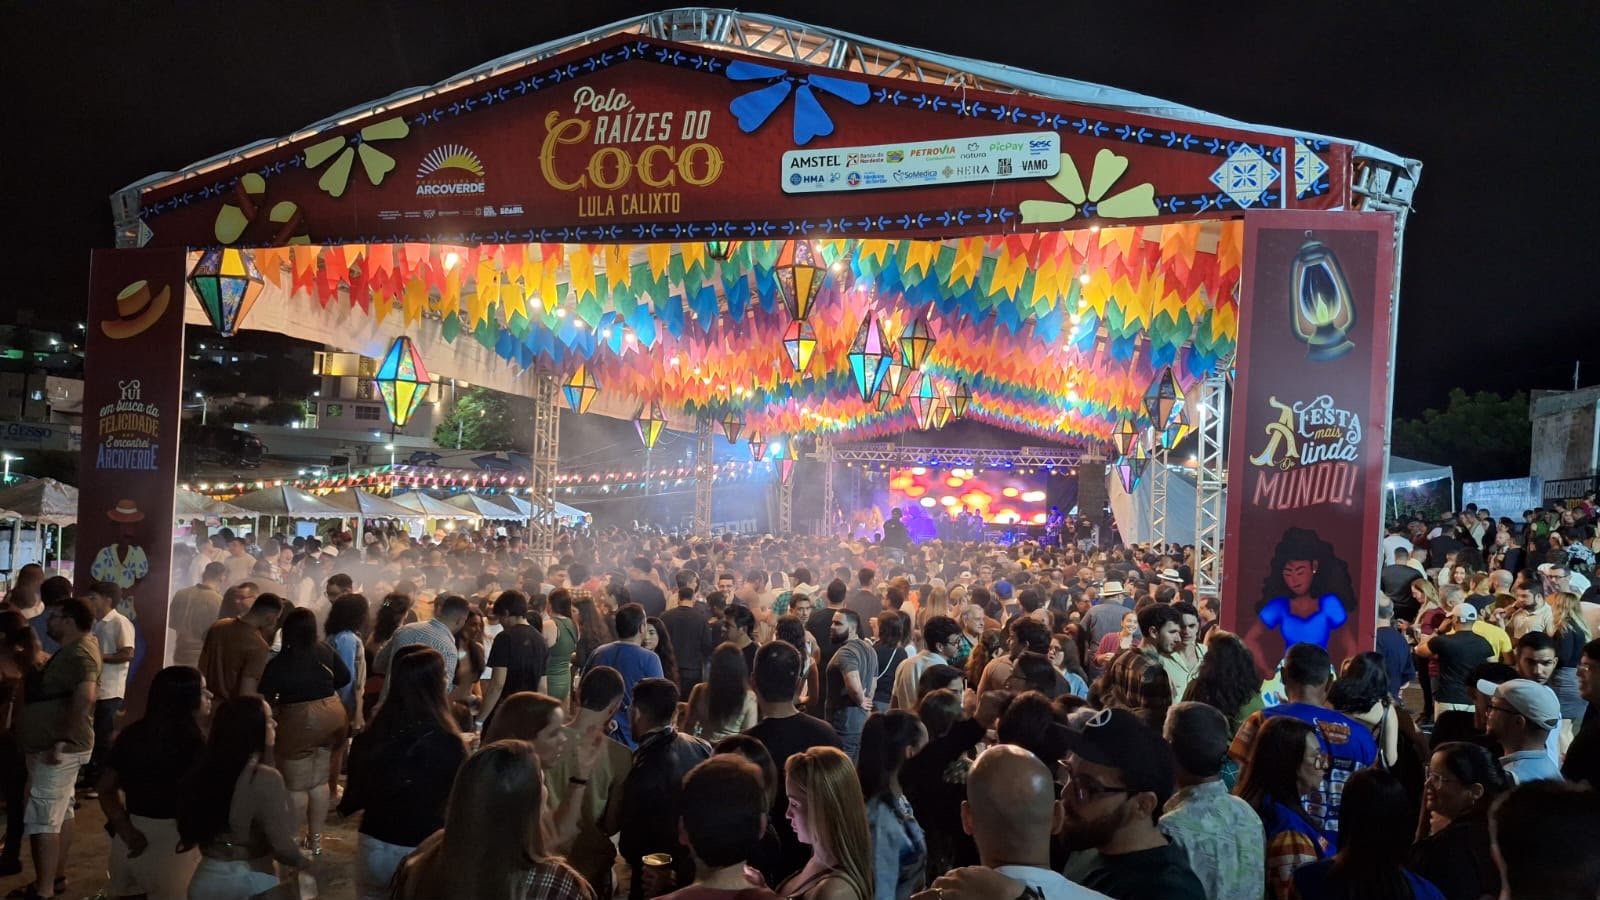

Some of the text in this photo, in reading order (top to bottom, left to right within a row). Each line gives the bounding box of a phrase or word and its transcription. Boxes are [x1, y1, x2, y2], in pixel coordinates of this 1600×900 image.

[574, 86, 631, 114] Polo
[594, 105, 711, 144] RAÍZES DO
[910, 145, 956, 157] PETROVIA
[989, 142, 1024, 152] PicPay
[791, 155, 840, 168] AMSTEL
[957, 165, 990, 175] HERA
[1022, 159, 1048, 171] VAMO
[416, 183, 485, 195] ARCOVERDE
[803, 175, 825, 184] HMA
[579, 192, 681, 217] LULA CALIXTO
[118, 379, 141, 400] FUI
[100, 400, 160, 418] em busca da
[99, 412, 160, 438] FELICIDADE
[1249, 394, 1362, 467] A FESTA
[1314, 425, 1342, 440] mais
[96, 443, 160, 470] ARCOVERDE
[1301, 438, 1359, 465] linda
[1252, 462, 1359, 510] MUNDO!
